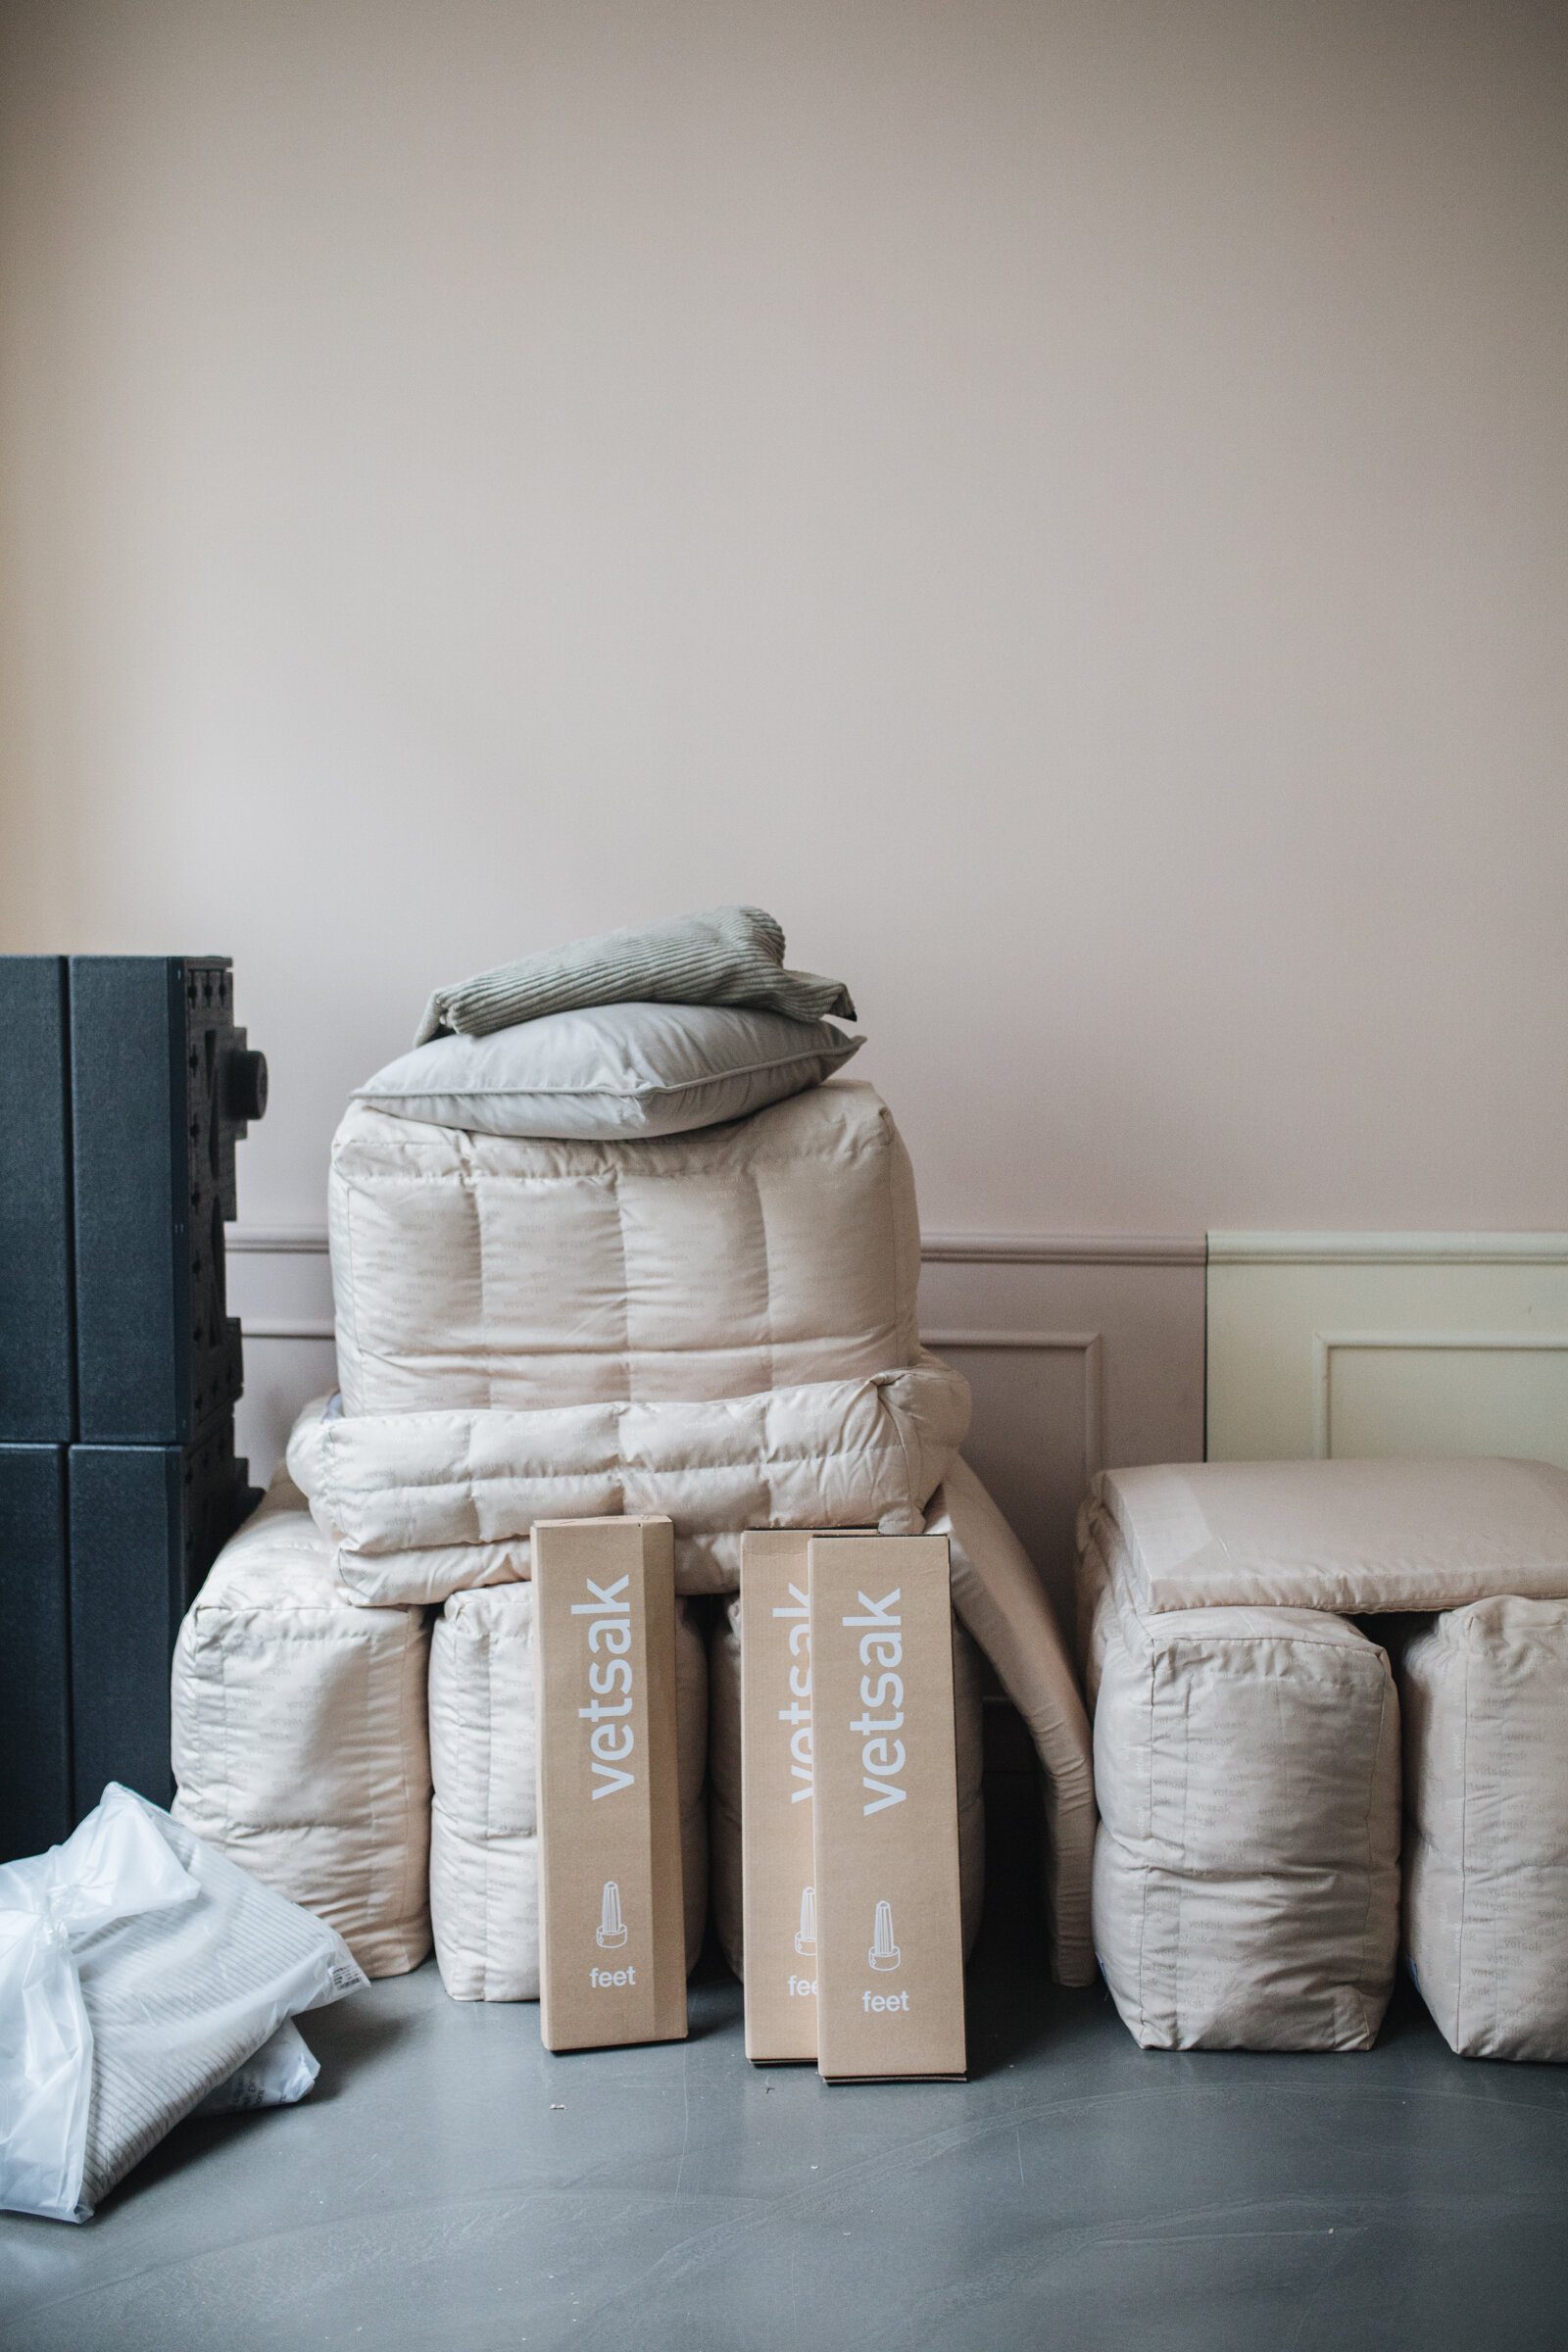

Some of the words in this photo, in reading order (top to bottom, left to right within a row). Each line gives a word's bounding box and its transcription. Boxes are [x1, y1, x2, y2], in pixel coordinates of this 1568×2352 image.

[570, 1574, 635, 1800] vetsak
[842, 1588, 906, 1816] vetsak
[589, 1966, 636, 1988] feet
[788, 1976, 817, 1996] fee
[862, 1990, 909, 2012] feet
